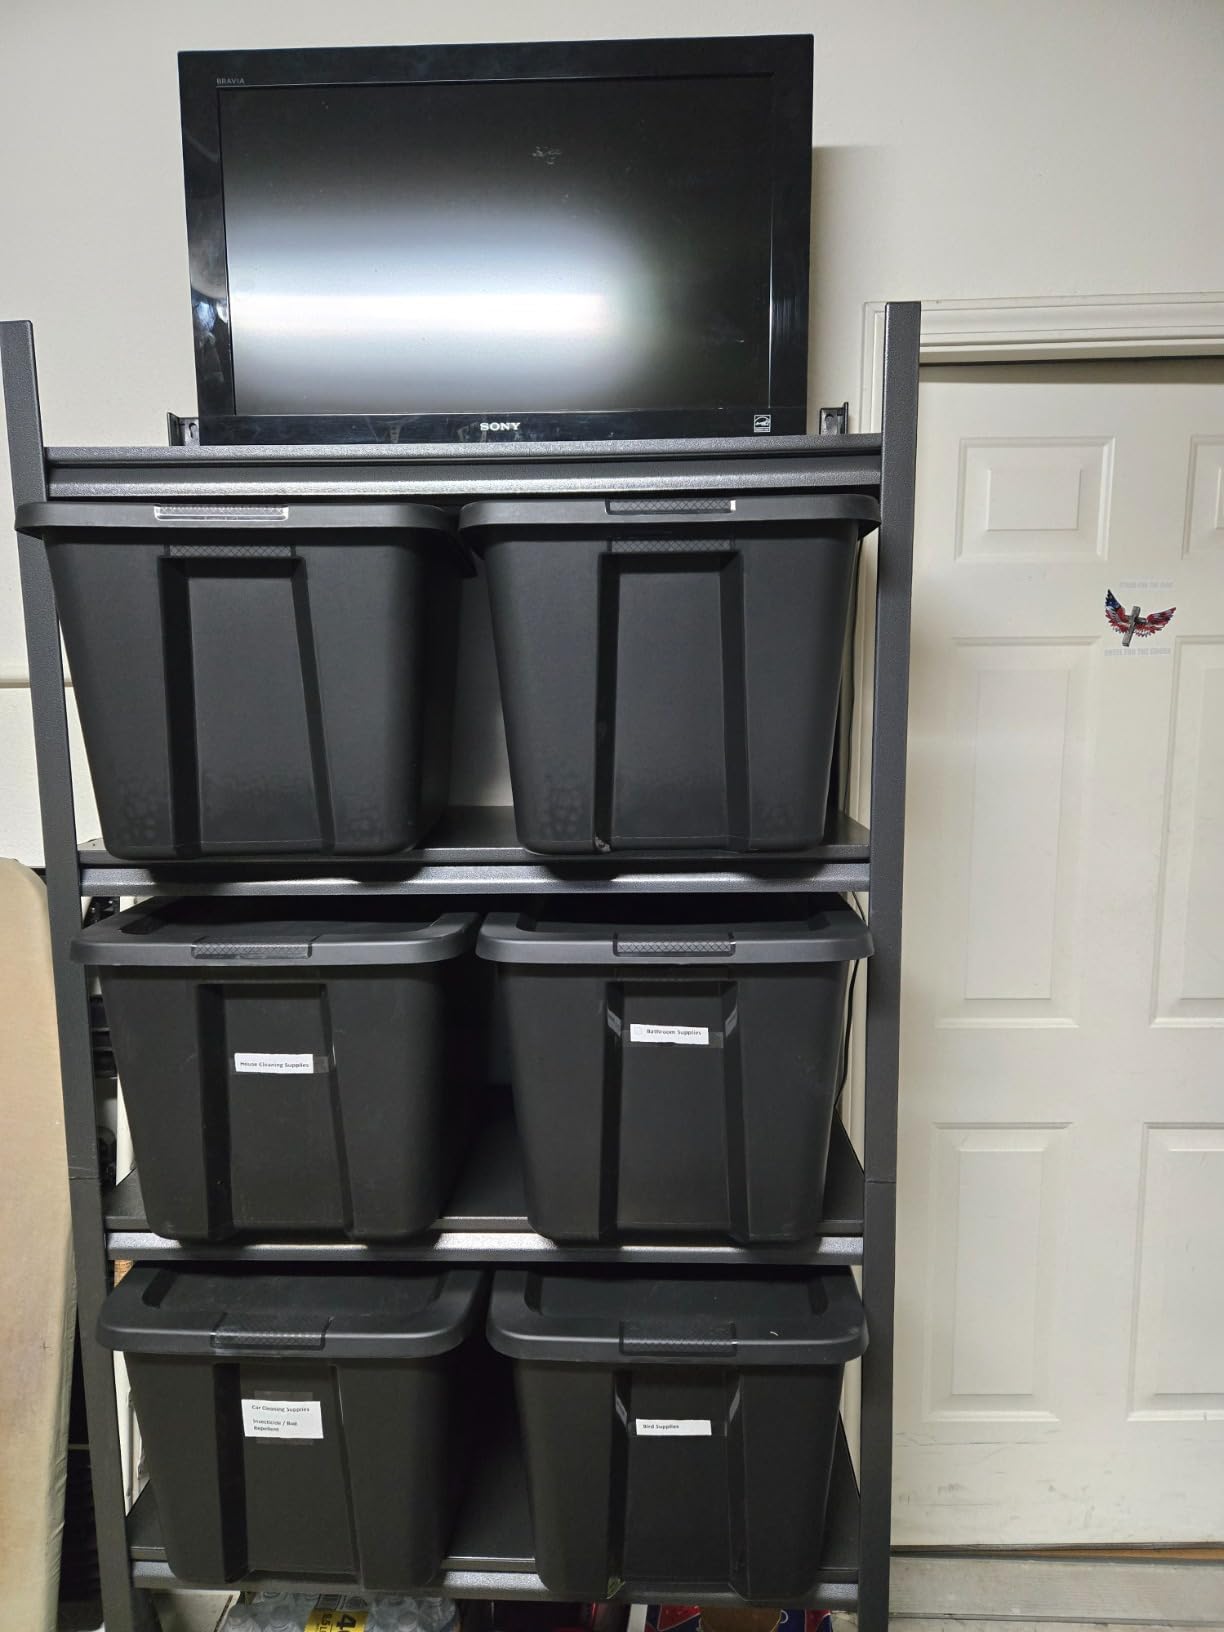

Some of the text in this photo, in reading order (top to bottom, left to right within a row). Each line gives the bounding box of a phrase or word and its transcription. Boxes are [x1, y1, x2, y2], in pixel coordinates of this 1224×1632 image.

[216, 77, 245, 85] BRAVIA
[479, 422, 521, 431] SONY
[252, 1418, 282, 1426] Insecticide
